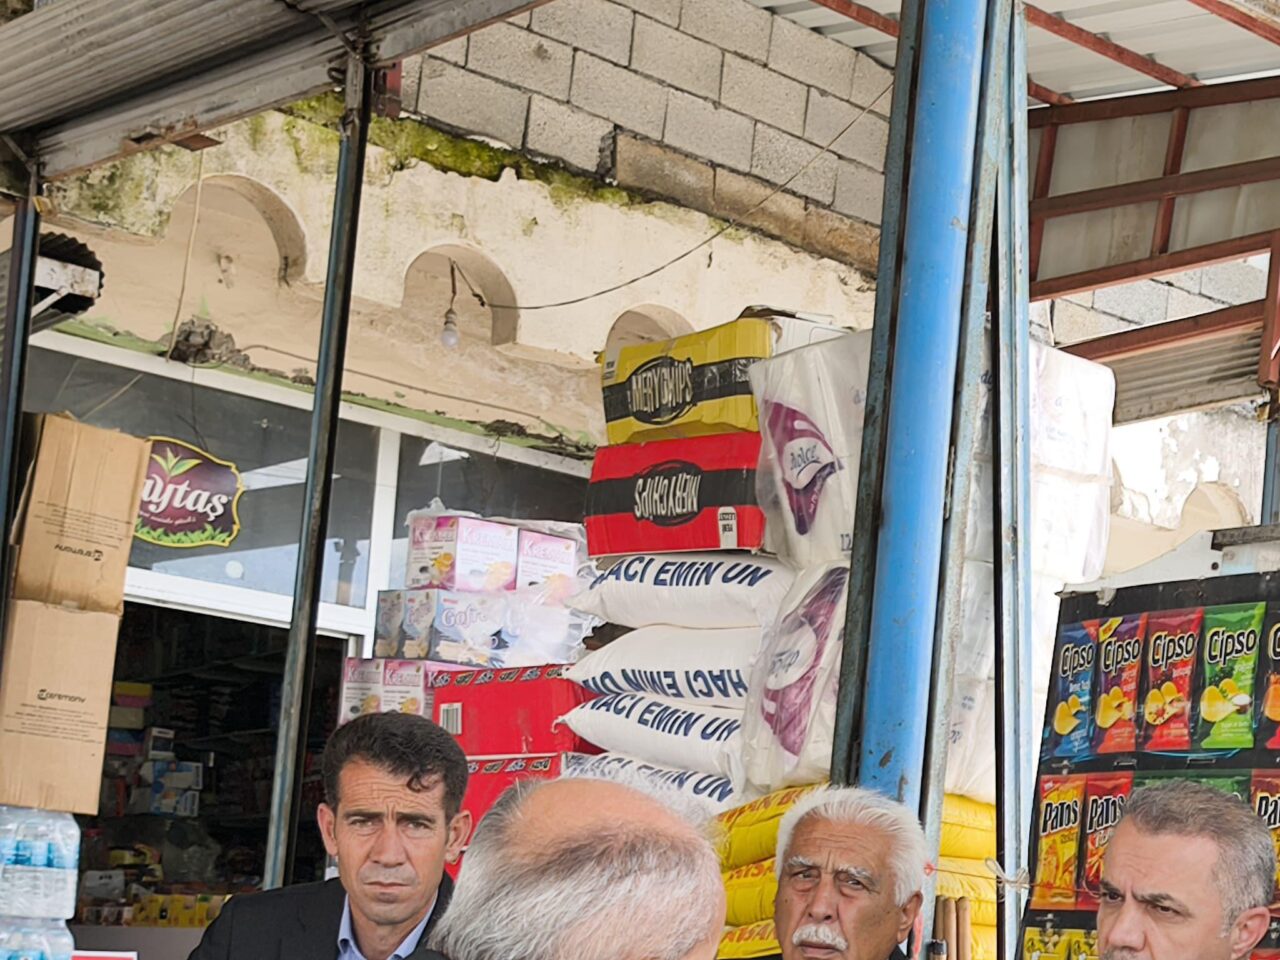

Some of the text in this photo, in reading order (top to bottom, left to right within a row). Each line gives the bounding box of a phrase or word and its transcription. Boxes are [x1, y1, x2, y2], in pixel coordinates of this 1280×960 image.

[1101, 637, 1142, 677] Cipso
[1150, 630, 1197, 672] Cipso
[1203, 627, 1258, 668] Cipso
